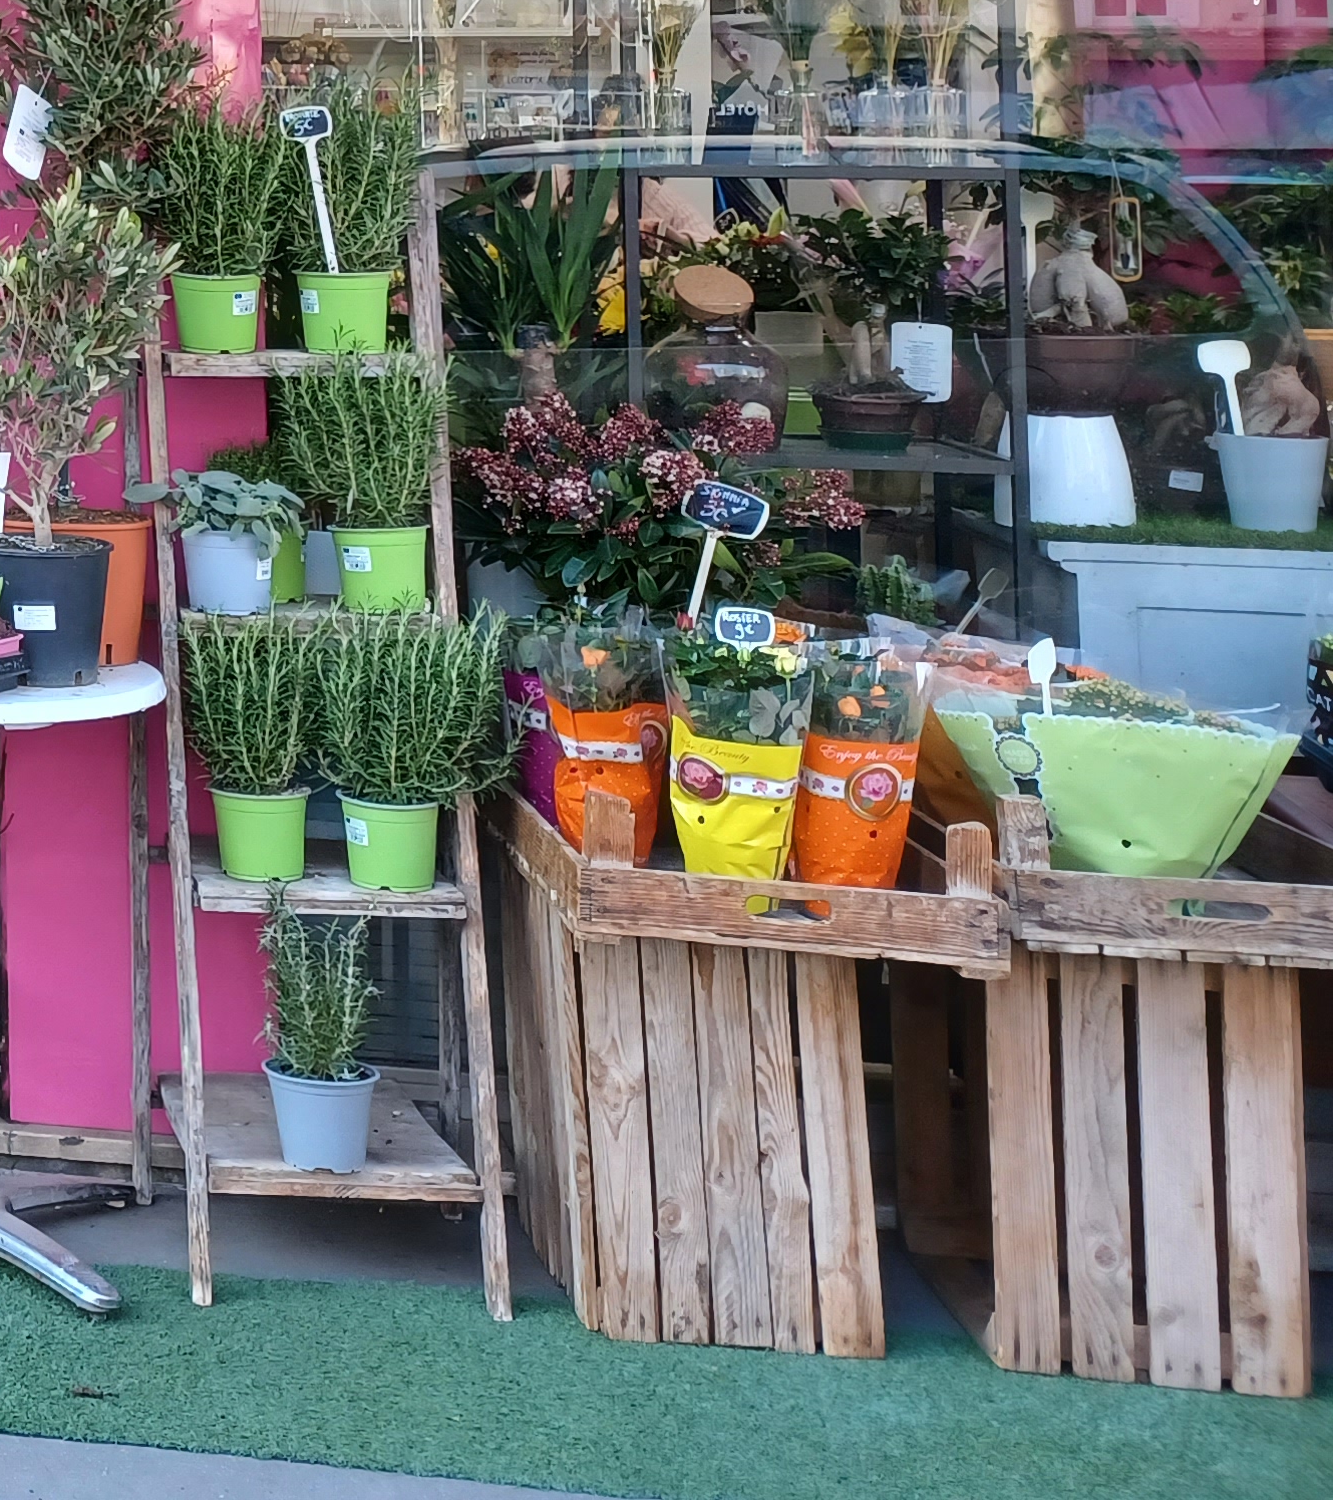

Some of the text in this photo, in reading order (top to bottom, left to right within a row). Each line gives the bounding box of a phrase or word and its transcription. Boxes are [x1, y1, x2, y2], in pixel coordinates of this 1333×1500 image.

[722, 611, 761, 624] ROSIER
[734, 623, 755, 640] 9€
[699, 741, 750, 765] Beauty
[819, 743, 863, 764] Enjoy
[864, 749, 884, 761] the
